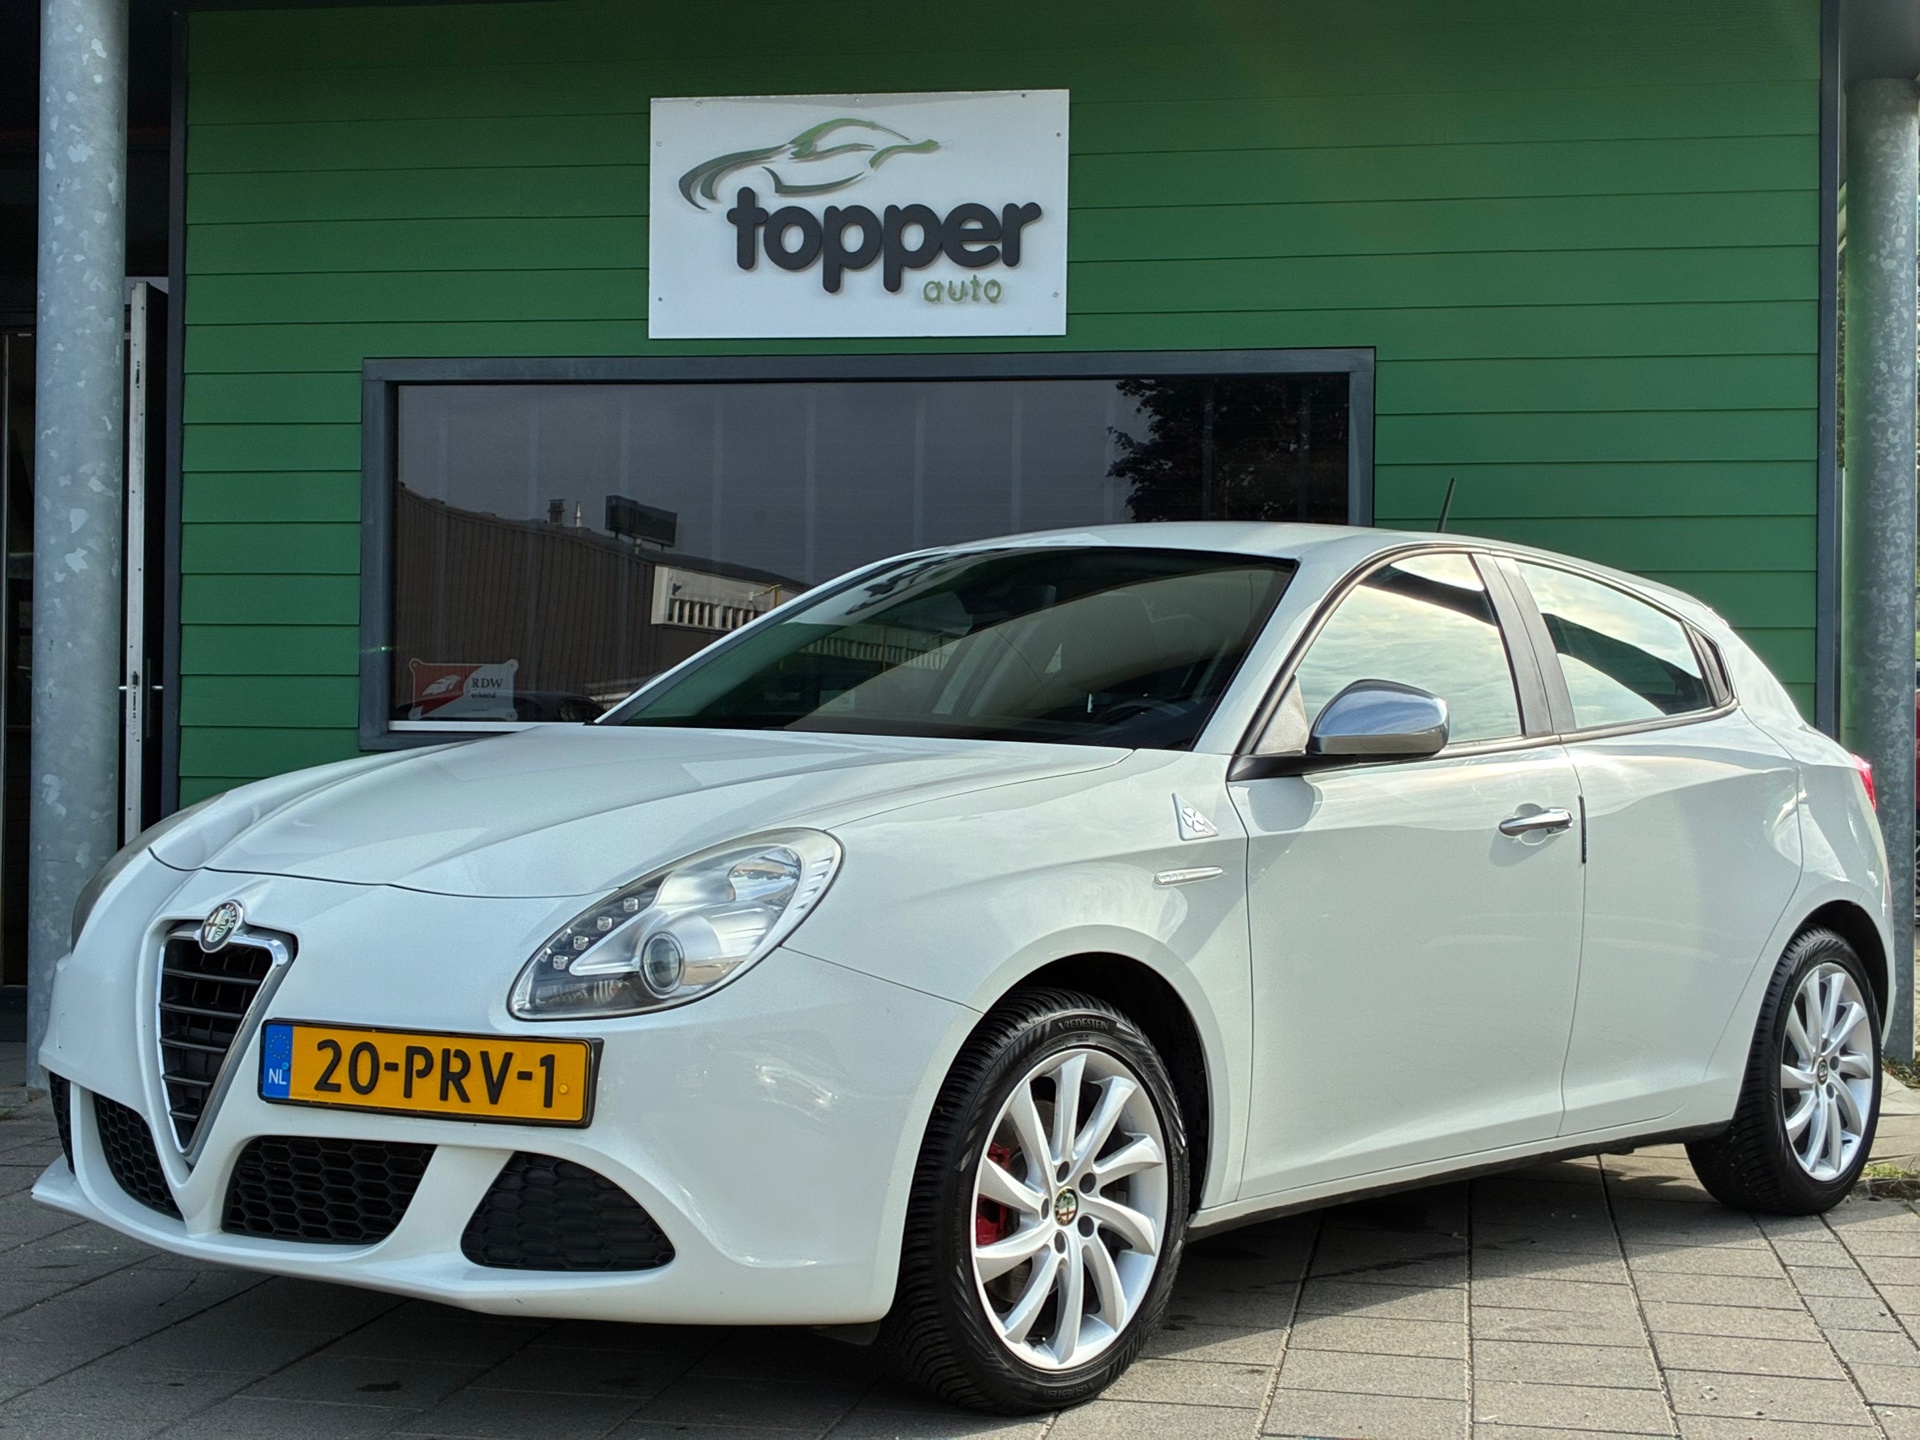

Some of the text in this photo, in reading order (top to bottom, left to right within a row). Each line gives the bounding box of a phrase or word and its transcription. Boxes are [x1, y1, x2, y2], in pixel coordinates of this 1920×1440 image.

[726, 186, 1042, 293] topper
[922, 274, 1002, 302] auto
[471, 677, 504, 689] RDW
[268, 1067, 288, 1086] NL
[313, 1038, 556, 1109] 20-PRV-1
